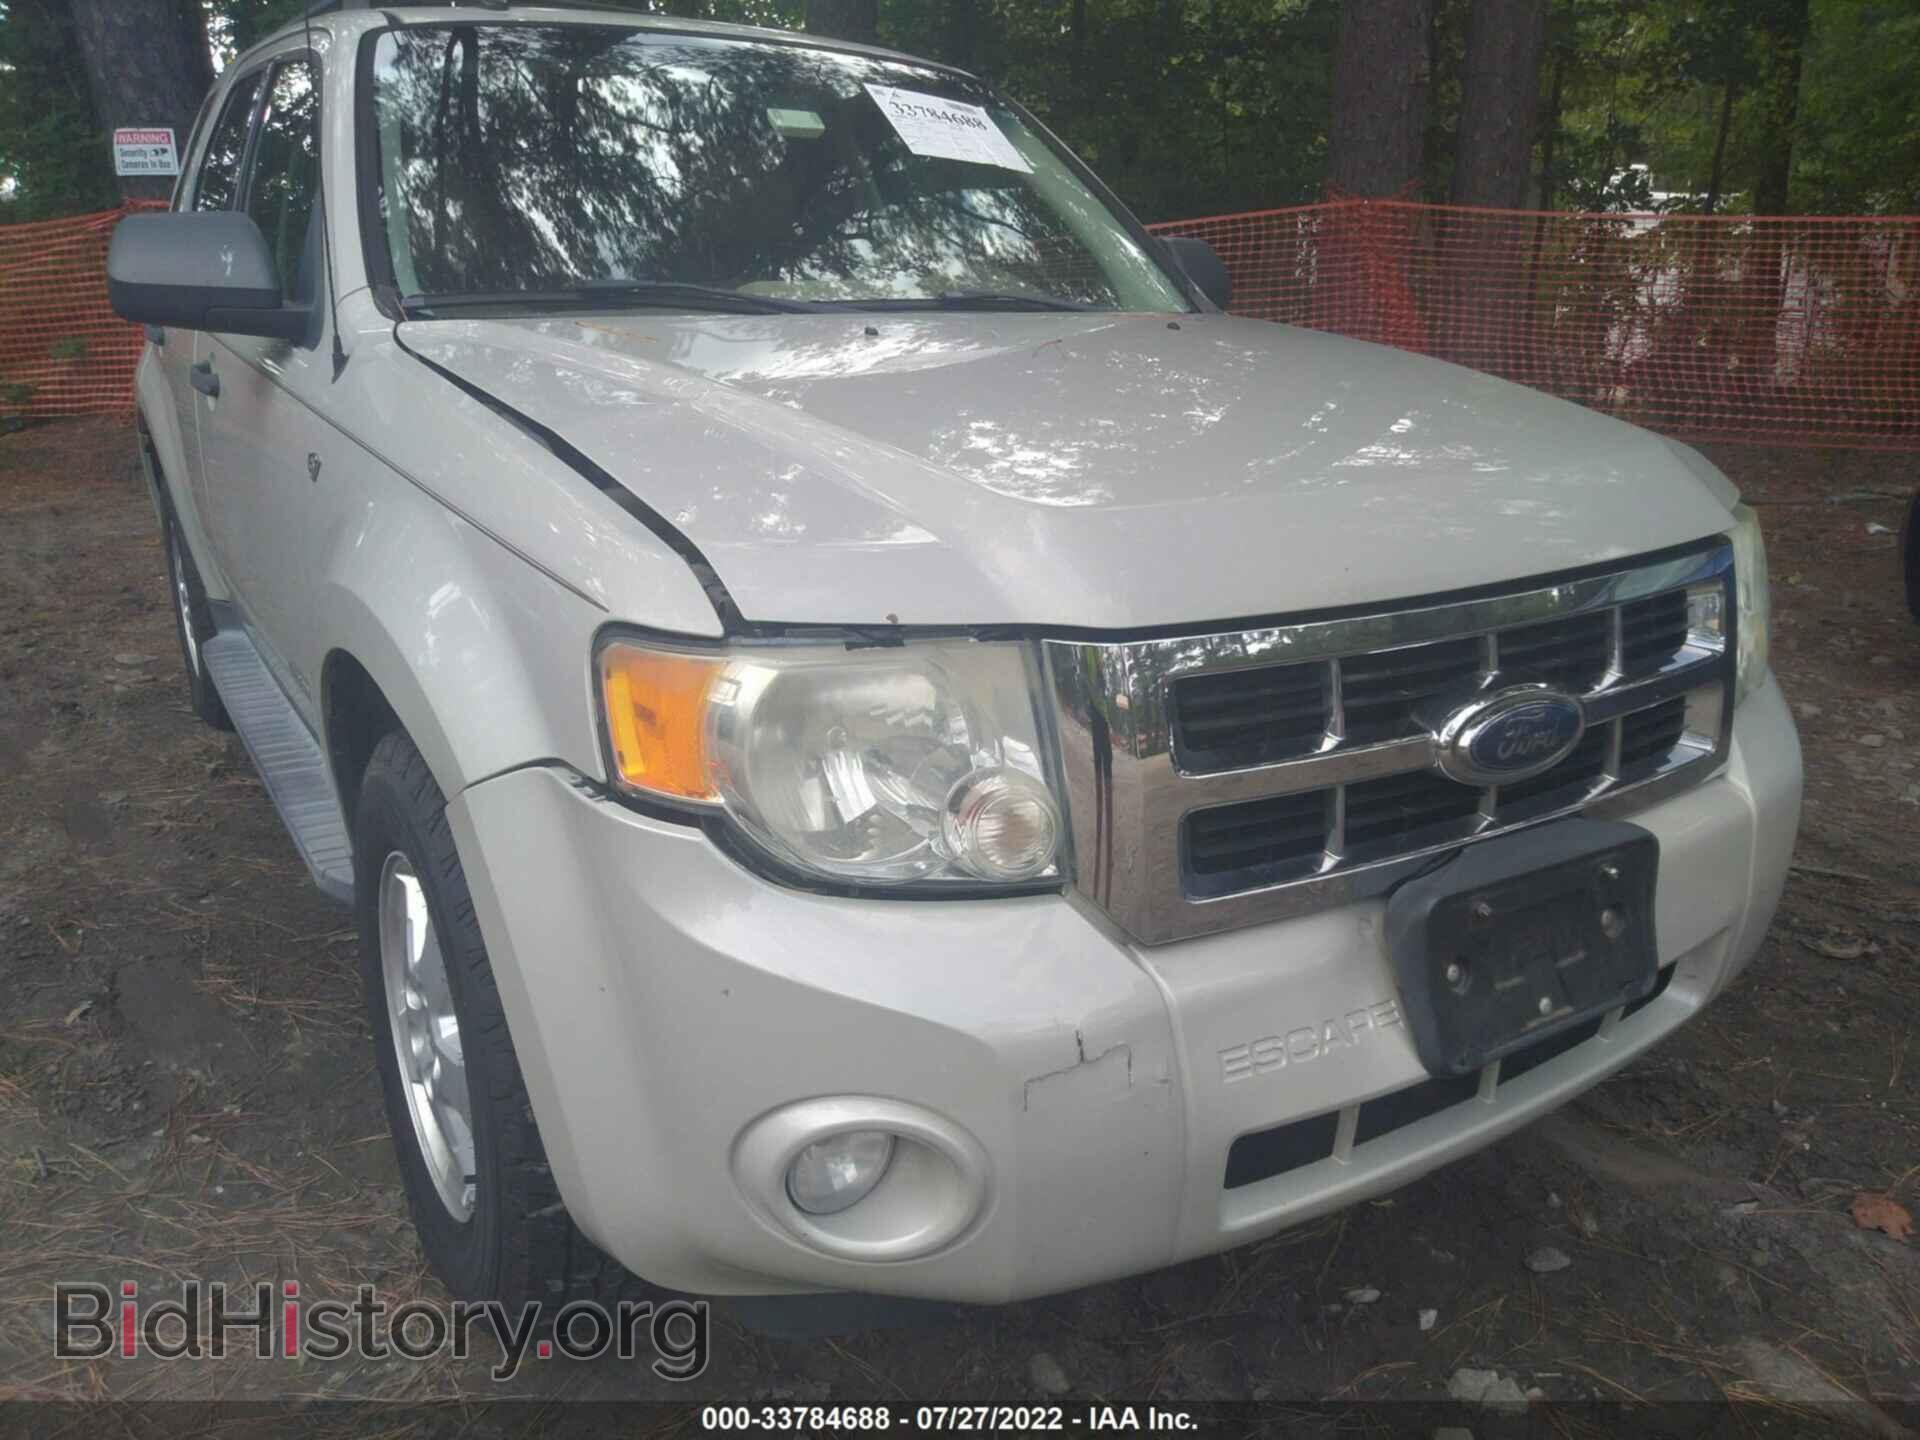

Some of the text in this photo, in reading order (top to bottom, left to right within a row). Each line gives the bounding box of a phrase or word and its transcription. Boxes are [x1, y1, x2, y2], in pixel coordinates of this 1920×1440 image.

[889, 101, 988, 131] 33784688
[118, 132, 169, 144] WARNING
[1497, 711, 1562, 760] Ford
